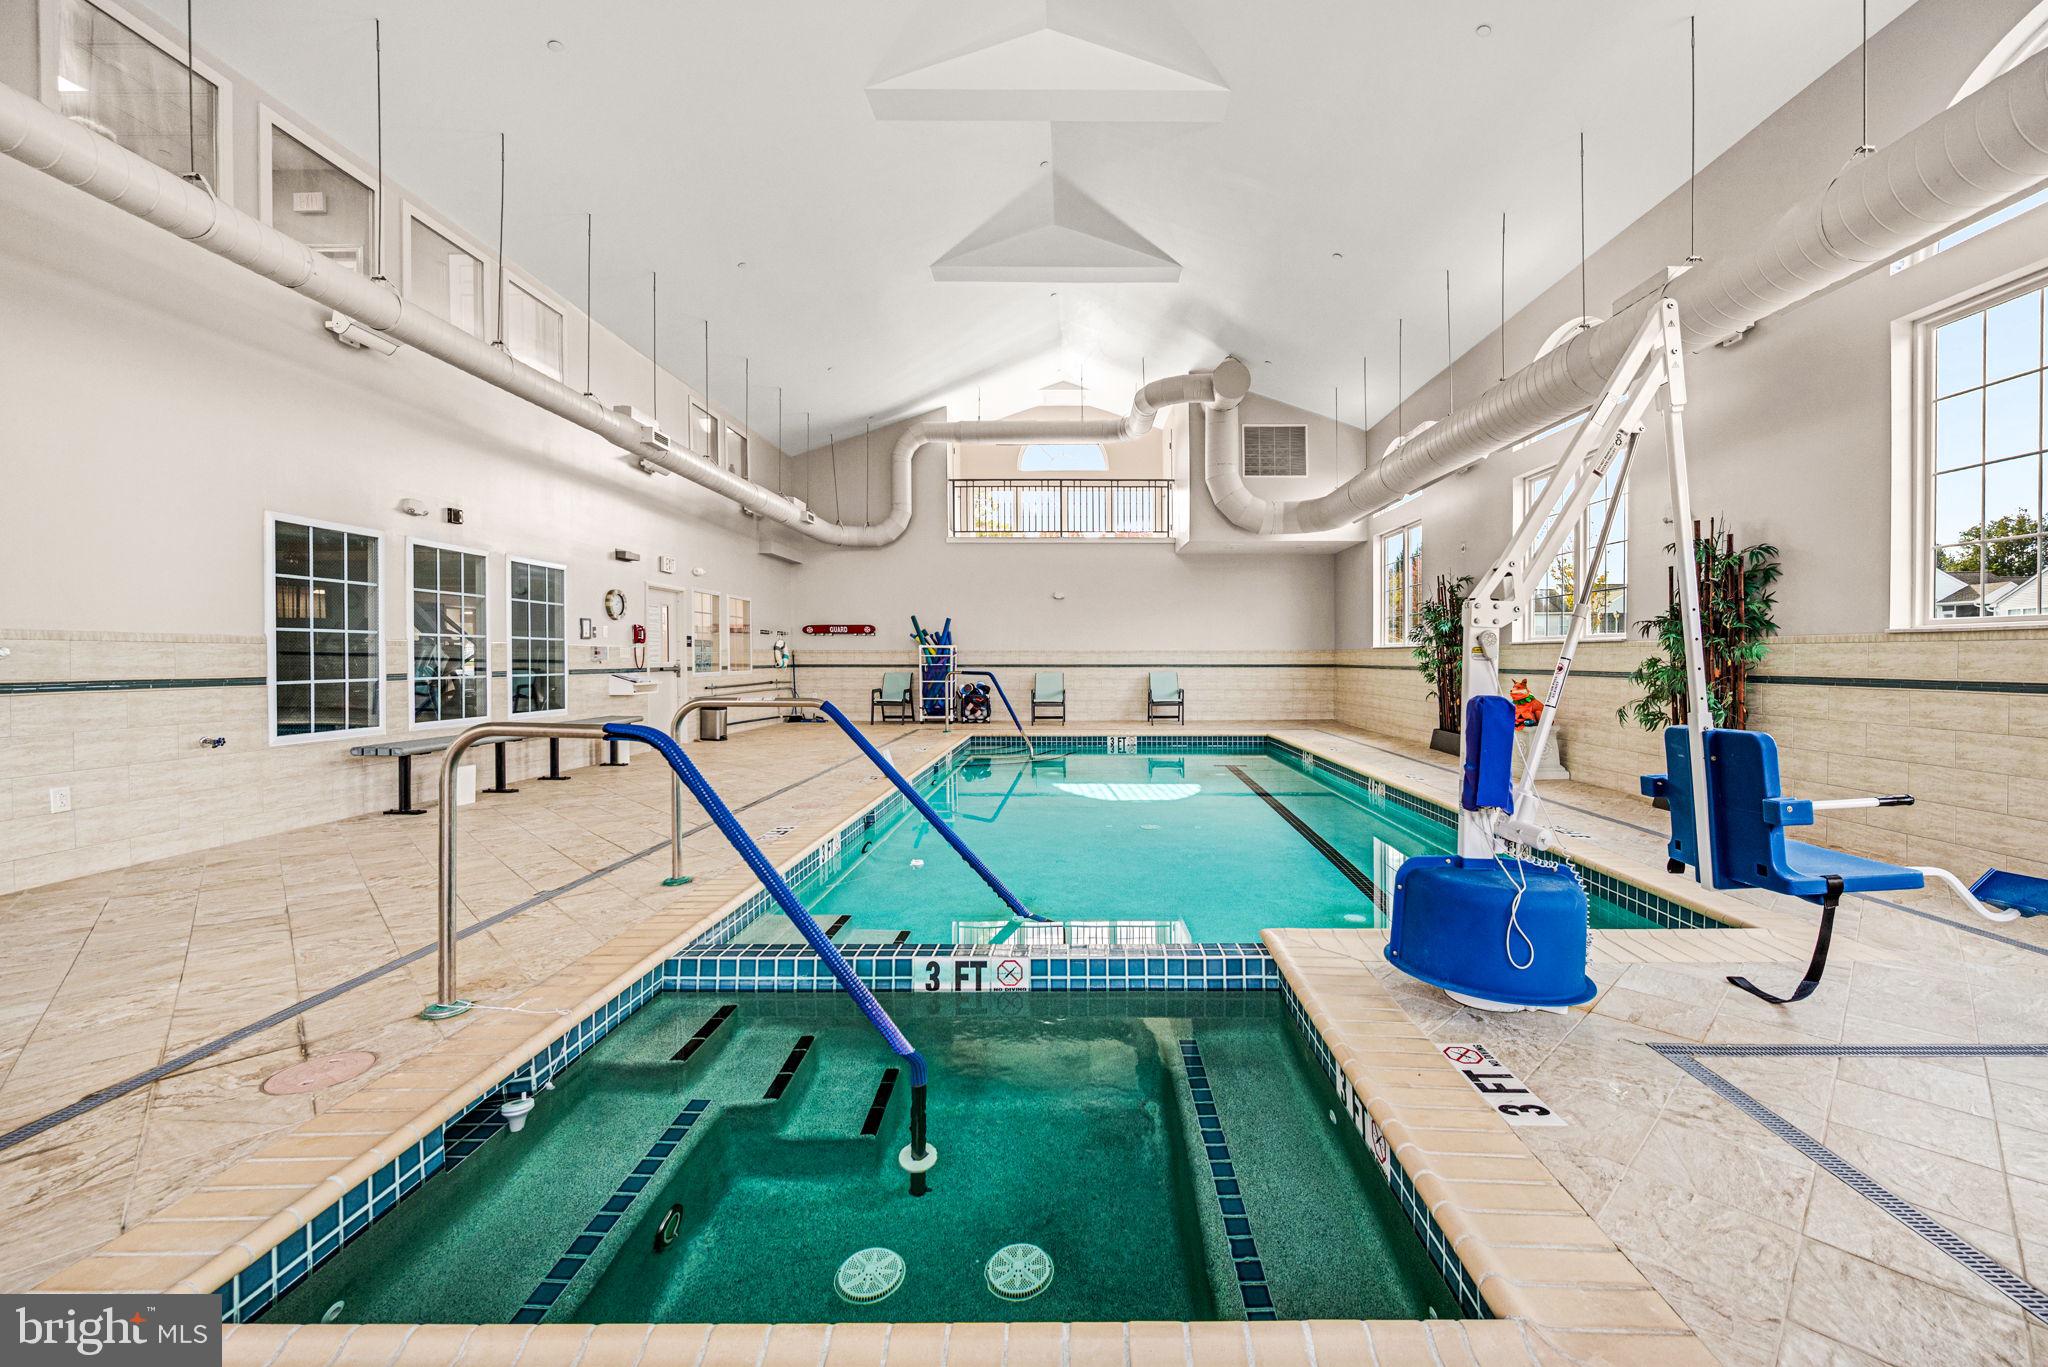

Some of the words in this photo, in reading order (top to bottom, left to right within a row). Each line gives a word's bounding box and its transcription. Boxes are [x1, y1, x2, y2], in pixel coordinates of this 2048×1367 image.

[925, 961, 940, 991] 3
[955, 961, 987, 991] FT
[1462, 1069, 1529, 1094] FT
[1340, 1067, 1347, 1107] 3
[1352, 1085, 1367, 1141] FT
[1499, 1104, 1550, 1116] 3
